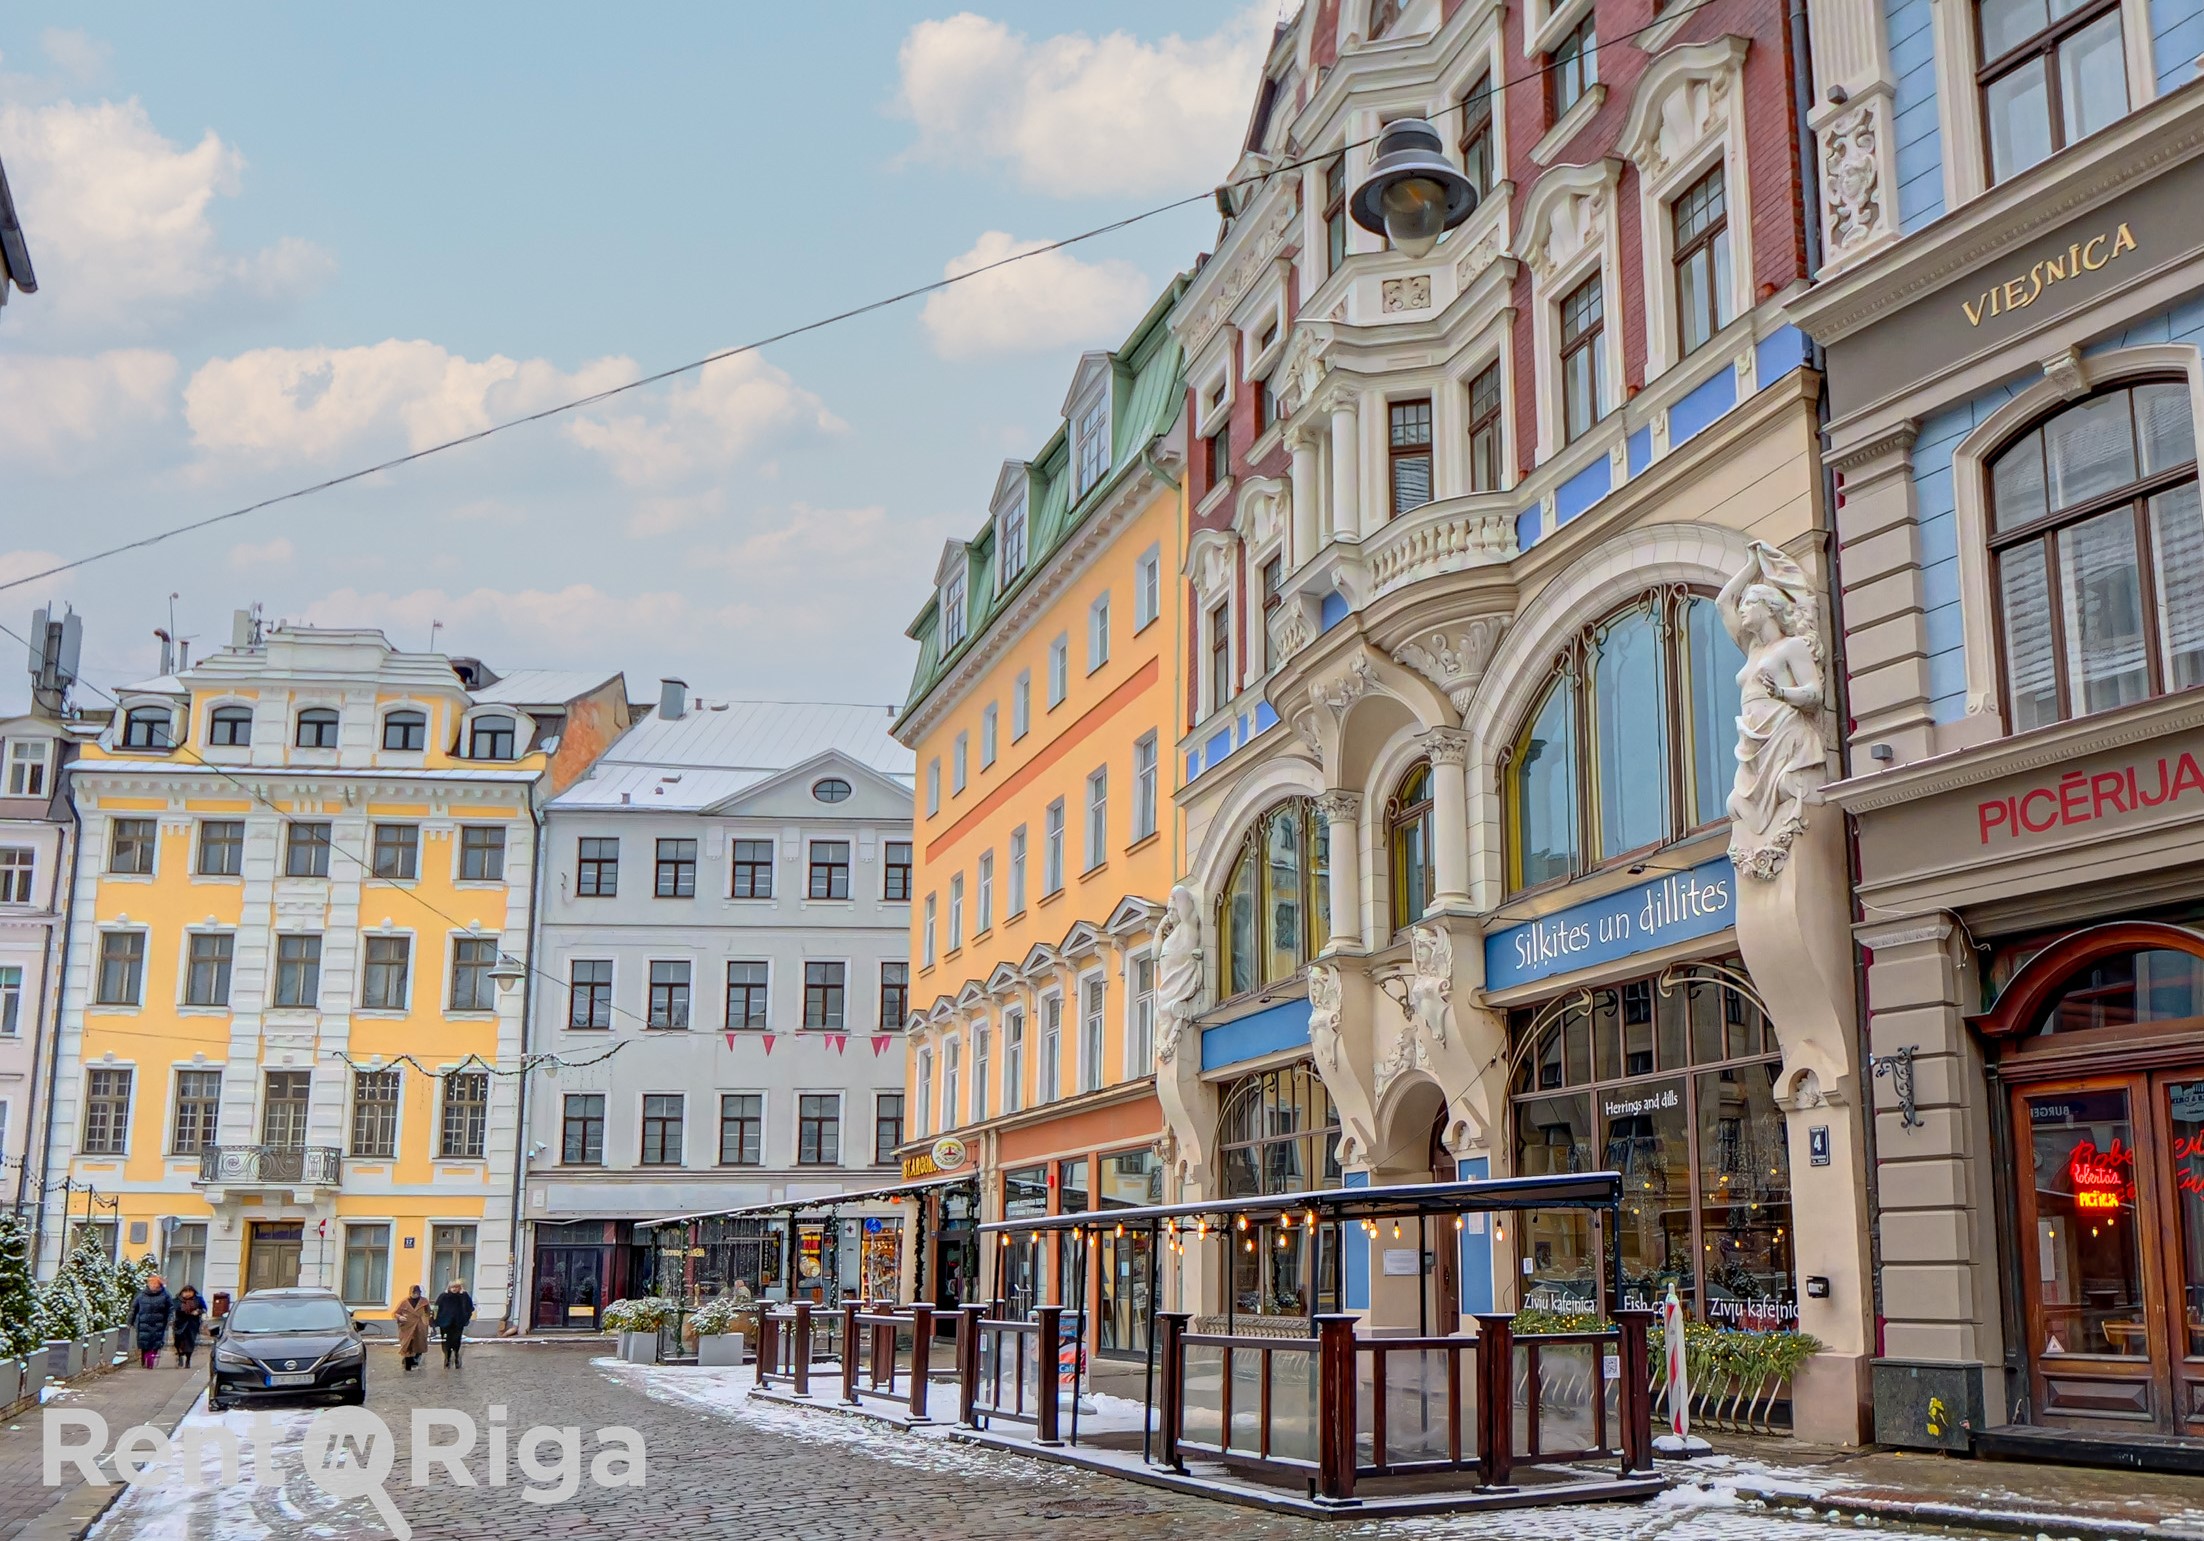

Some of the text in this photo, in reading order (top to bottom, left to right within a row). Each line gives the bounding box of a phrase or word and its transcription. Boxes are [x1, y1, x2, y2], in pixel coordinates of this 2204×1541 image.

[1962, 223, 2138, 327] VIESNĪCA
[1978, 752, 2204, 845] PICĒRIJA
[1515, 876, 1728, 970] Siļķites un dillites
[1605, 1089, 1678, 1116] Herrings and dills
[1814, 1134, 1822, 1151] 4
[1524, 1293, 1549, 1314] Zivju
[1710, 1298, 1743, 1323] Zivju
